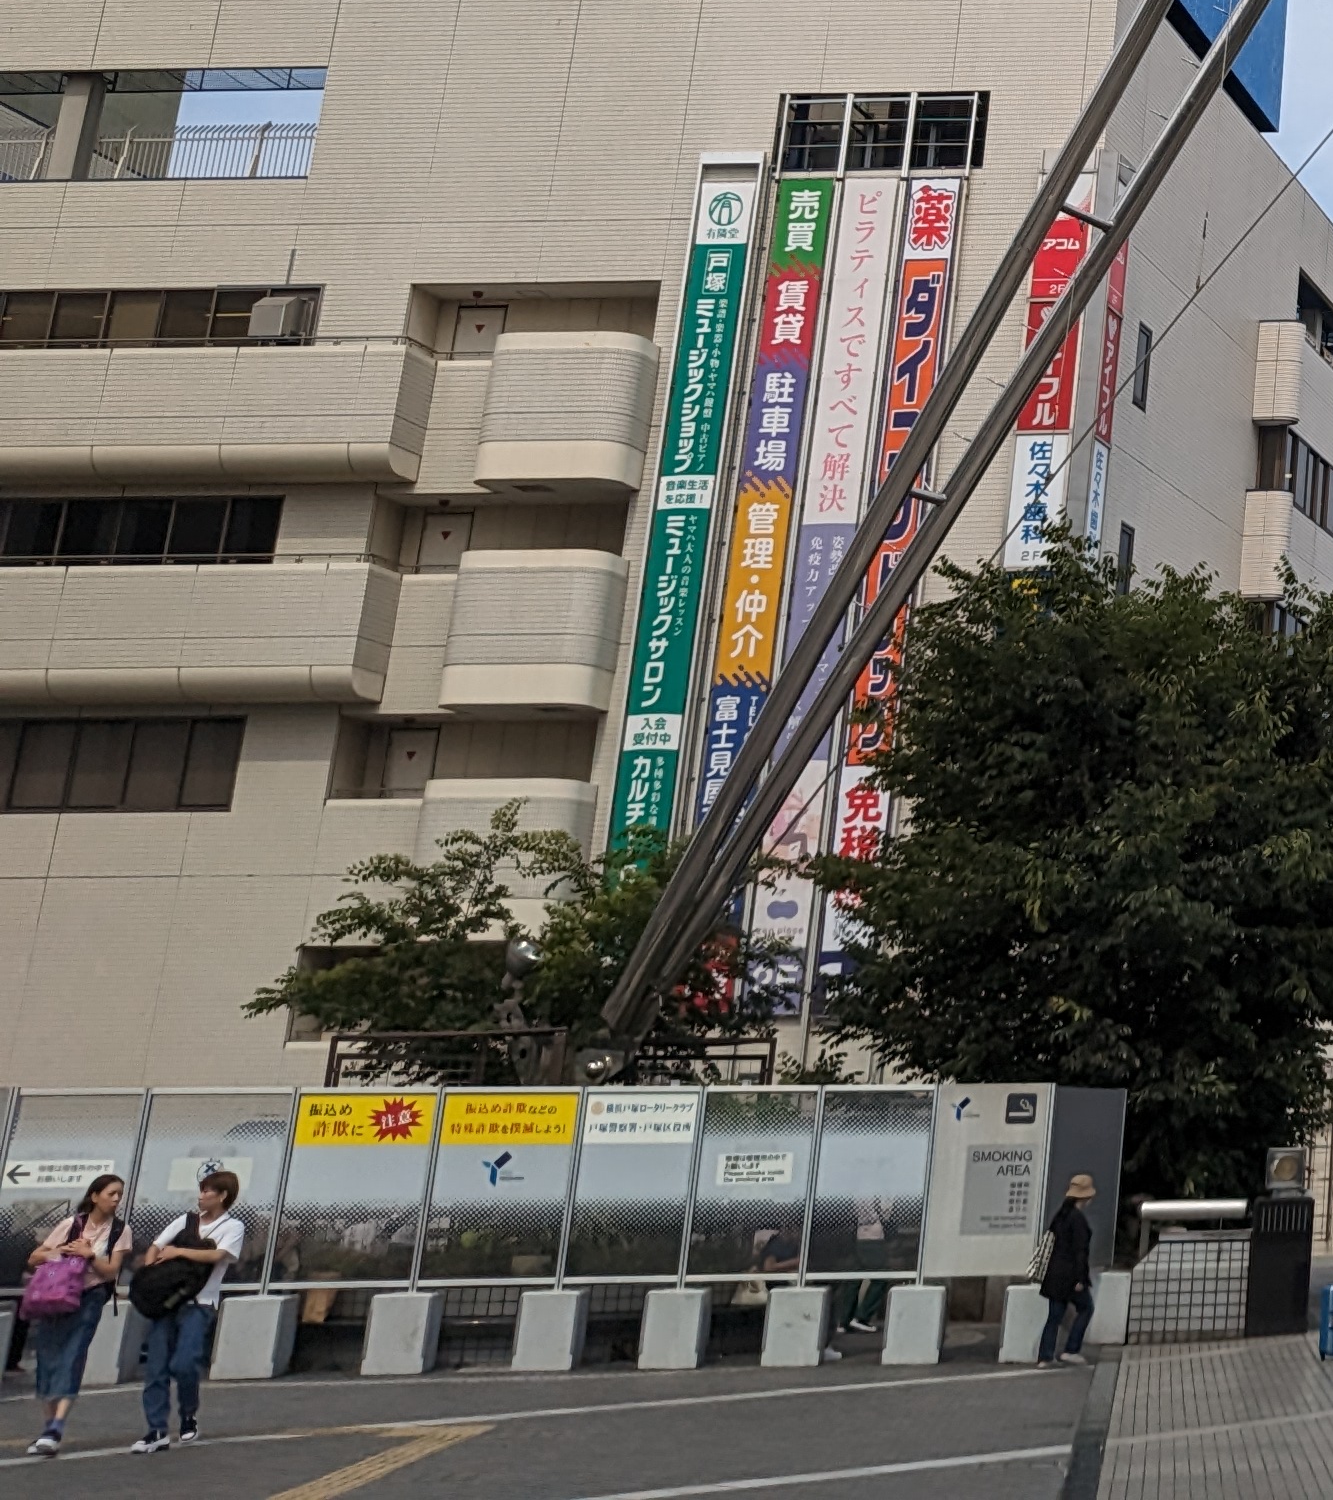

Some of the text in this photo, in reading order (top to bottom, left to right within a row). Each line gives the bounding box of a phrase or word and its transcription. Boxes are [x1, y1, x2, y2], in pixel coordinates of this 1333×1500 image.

[706, 227, 740, 240] 有隣堂
[785, 189, 823, 252] 売買
[909, 185, 956, 251] 薬
[1042, 237, 1080, 251] アコム
[704, 253, 730, 292] 戸塚
[771, 280, 810, 346] 賃貸
[817, 191, 879, 514] ピラティスですべて解決
[674, 298, 716, 474] ミュージックショップ
[753, 371, 795, 473] 駐車場
[665, 479, 709, 492] 音楽生活
[1020, 440, 1053, 546] 佐々木歯科
[729, 501, 780, 659] 管理・仲介
[640, 515, 686, 709] ミュージックサロン
[633, 732, 672, 747] 受付中
[640, 717, 667, 730] 入会
[309, 1103, 353, 1117] 振込め
[313, 1121, 364, 1138] 詐欺に
[972, 1149, 1033, 1162] SMOKING
[996, 1164, 1031, 1176] AREA
